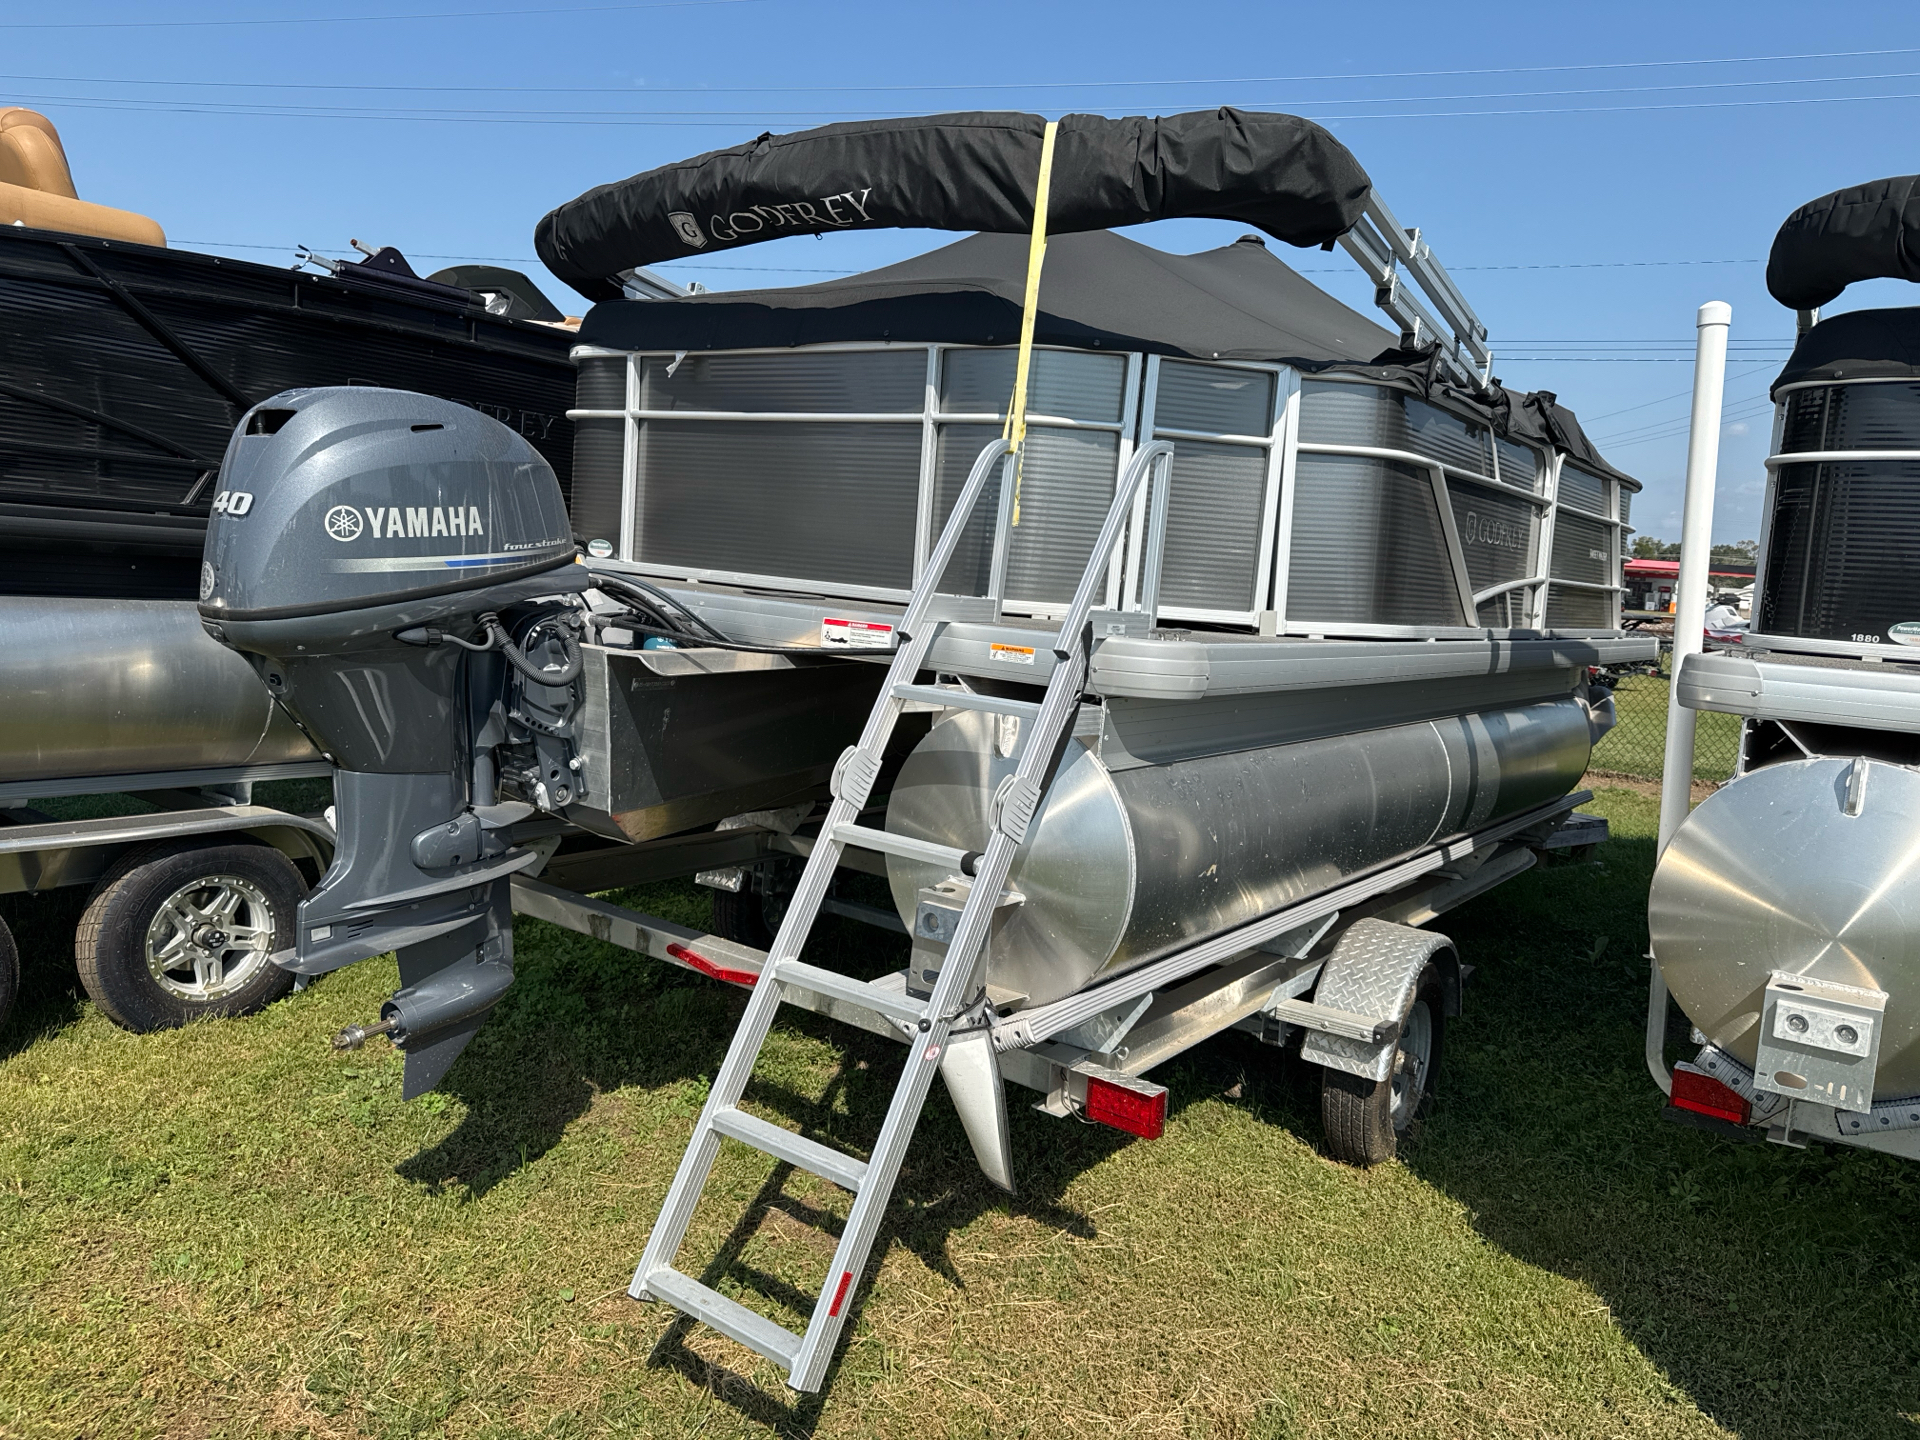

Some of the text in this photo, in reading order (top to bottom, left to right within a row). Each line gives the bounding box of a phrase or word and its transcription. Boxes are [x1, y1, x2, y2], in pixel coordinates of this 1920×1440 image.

[710, 187, 875, 241] GODFREY
[213, 490, 254, 515] 40
[365, 506, 484, 539] YAMAHA
[1479, 518, 1524, 552] GODFREY
[1850, 633, 1881, 644] 1880
